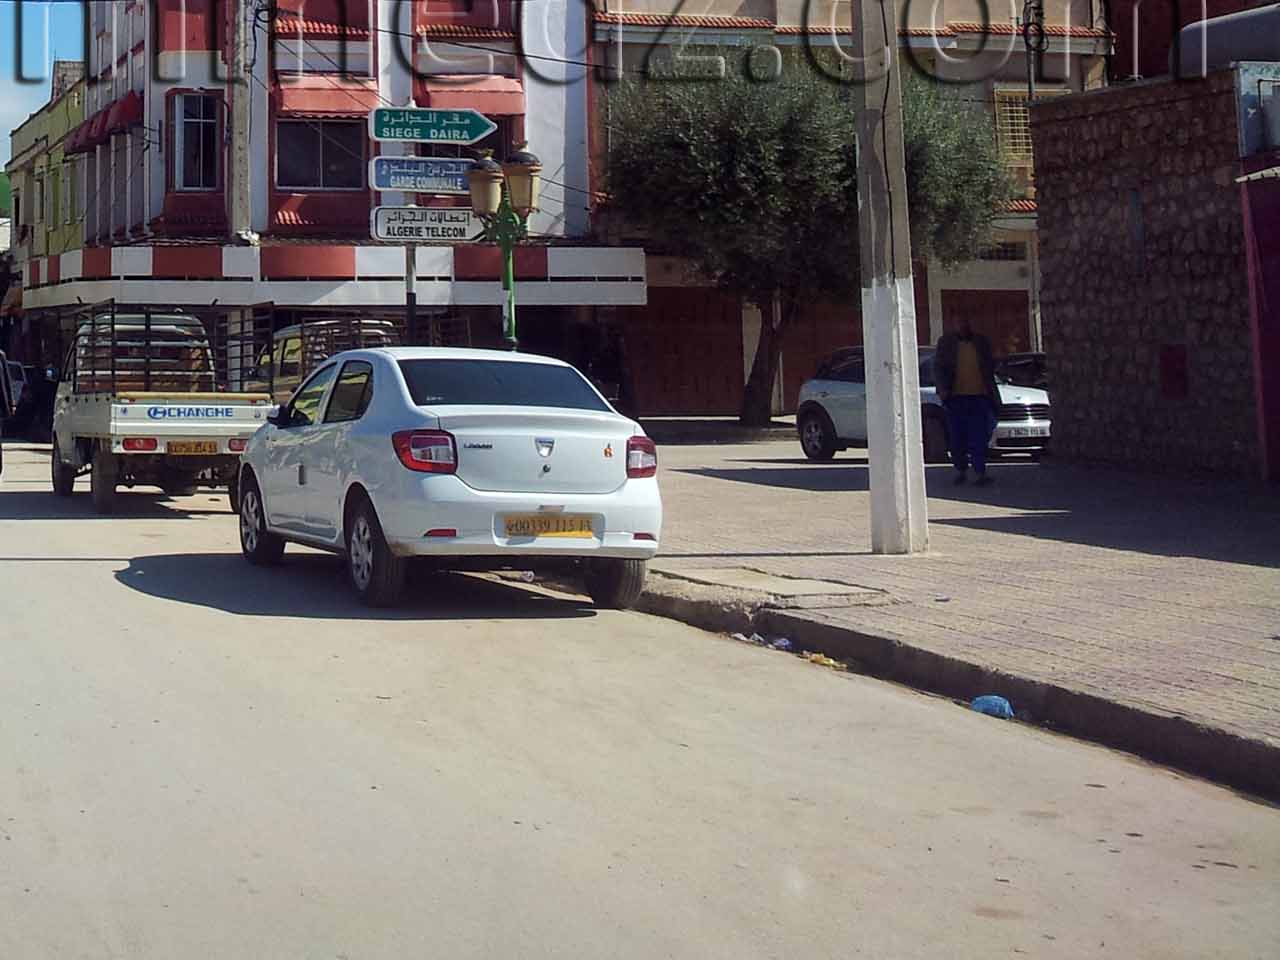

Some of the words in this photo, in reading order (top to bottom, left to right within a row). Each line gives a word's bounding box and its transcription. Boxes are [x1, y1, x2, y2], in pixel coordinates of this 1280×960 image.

[382, 128, 421, 138] SIEGE
[429, 129, 470, 140] DAIRA
[390, 175, 416, 188] GARDE
[386, 226, 423, 237] ALGERIE
[424, 226, 466, 238] TELECOM
[167, 407, 234, 418] CHANGHE
